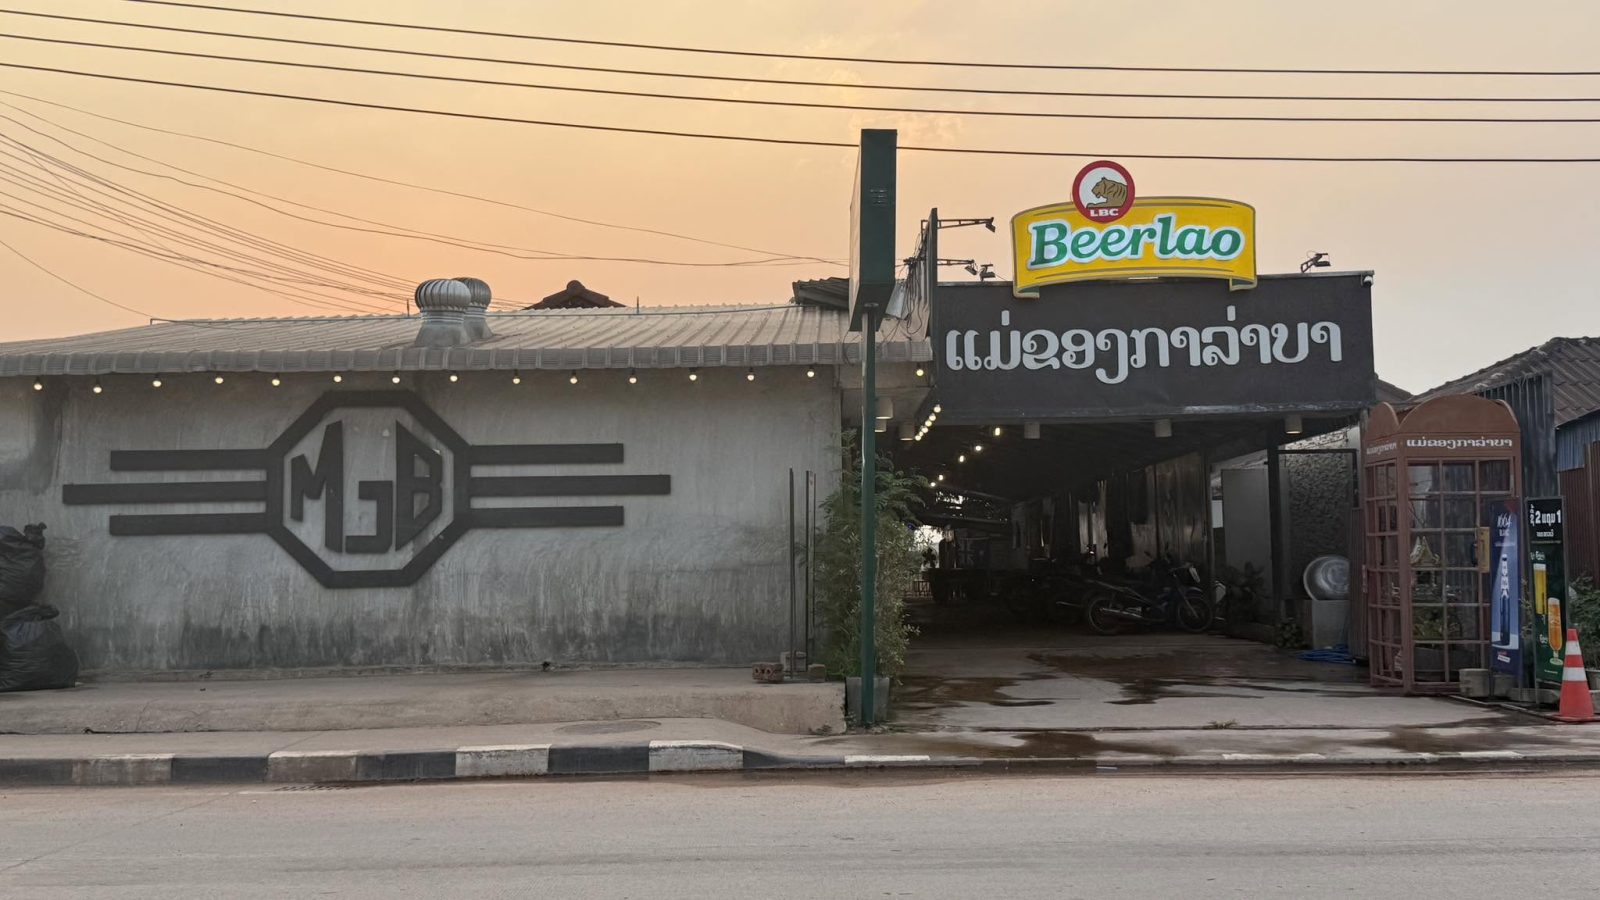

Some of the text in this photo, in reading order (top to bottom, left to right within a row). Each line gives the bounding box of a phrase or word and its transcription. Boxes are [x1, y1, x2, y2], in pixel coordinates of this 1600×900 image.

[1090, 208, 1119, 217] LBC
[1028, 213, 1244, 268] Beerlao
[291, 420, 442, 553] MGB
[1535, 510, 1541, 524] 2
